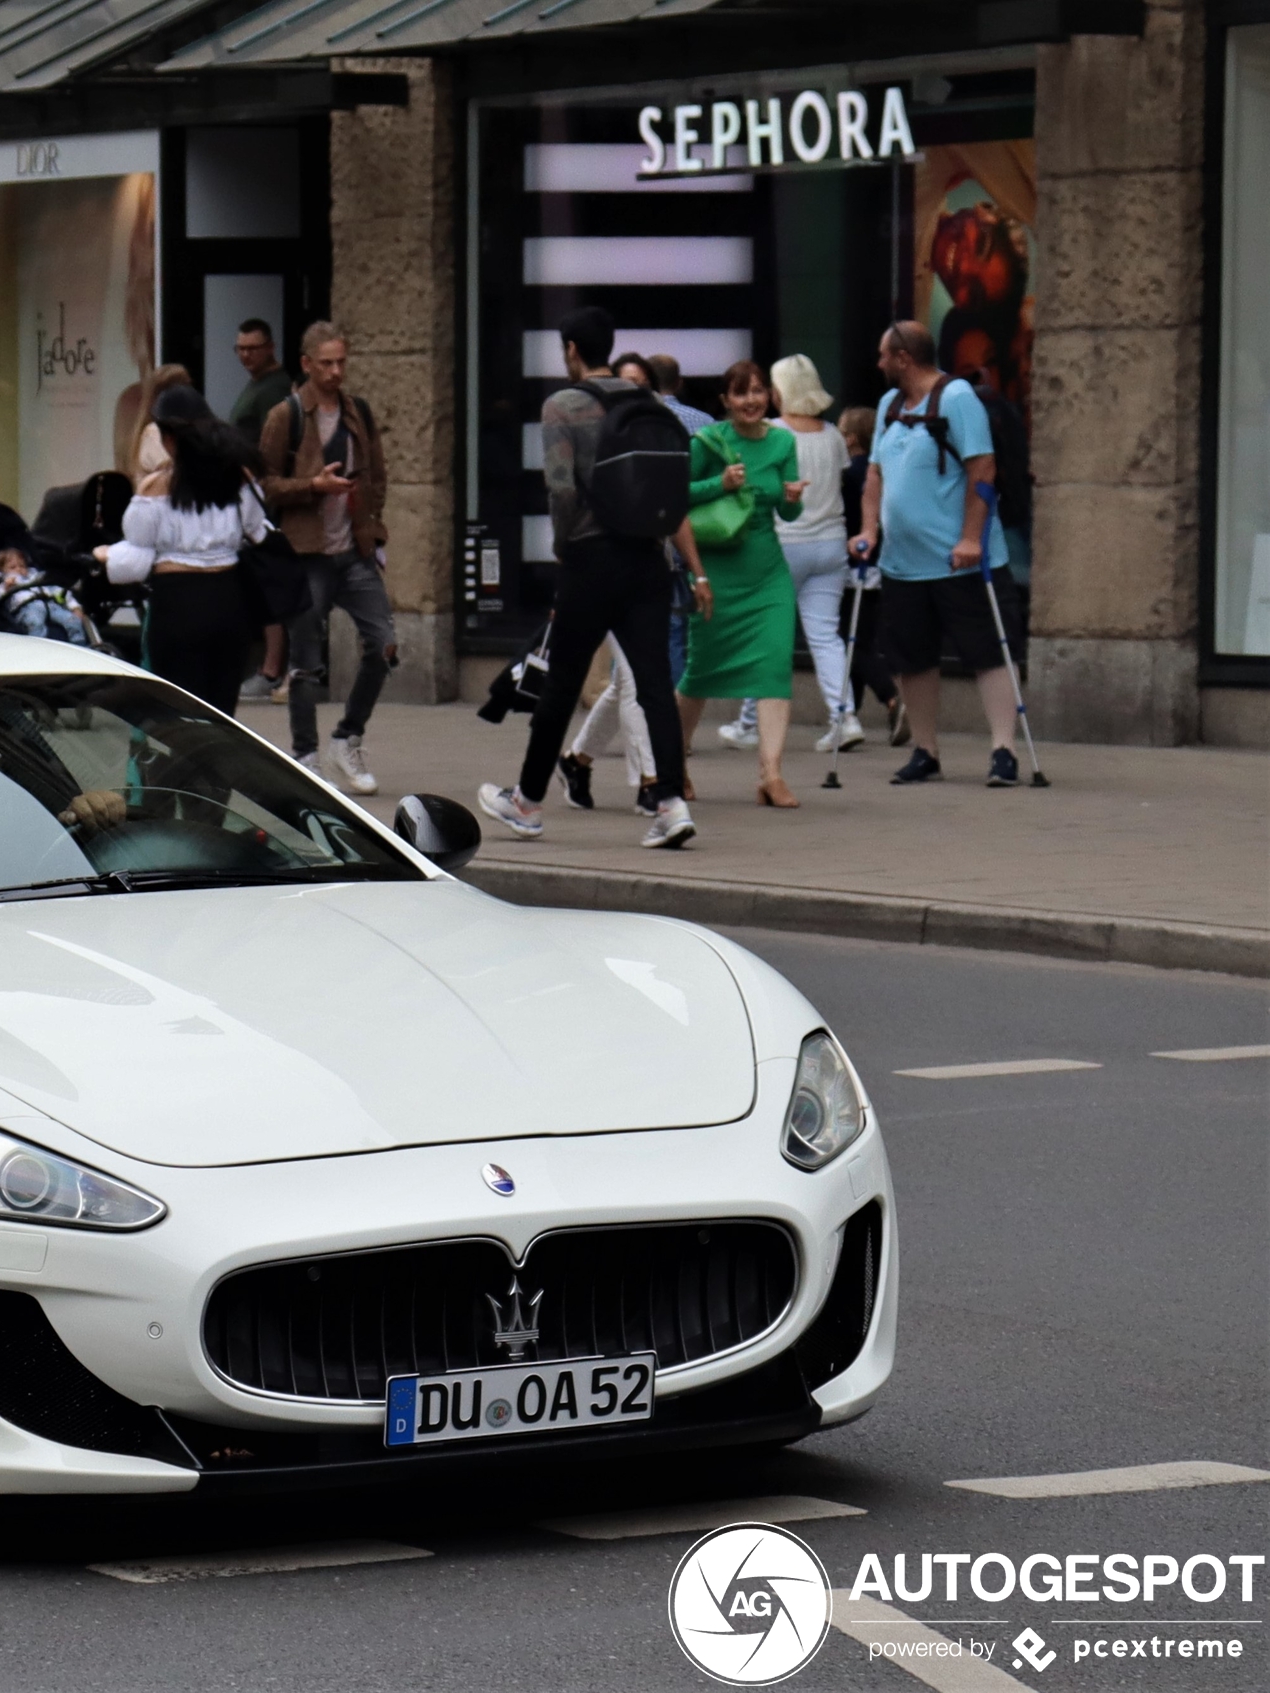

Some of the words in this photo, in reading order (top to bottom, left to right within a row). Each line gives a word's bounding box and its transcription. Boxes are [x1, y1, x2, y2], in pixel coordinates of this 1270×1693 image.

[638, 87, 917, 173] SEPHORA
[16, 141, 61, 175] DIOR
[417, 1379, 483, 1435] DU
[516, 1370, 579, 1425] OA
[589, 1363, 650, 1418] 52
[395, 1418, 407, 1434] D
